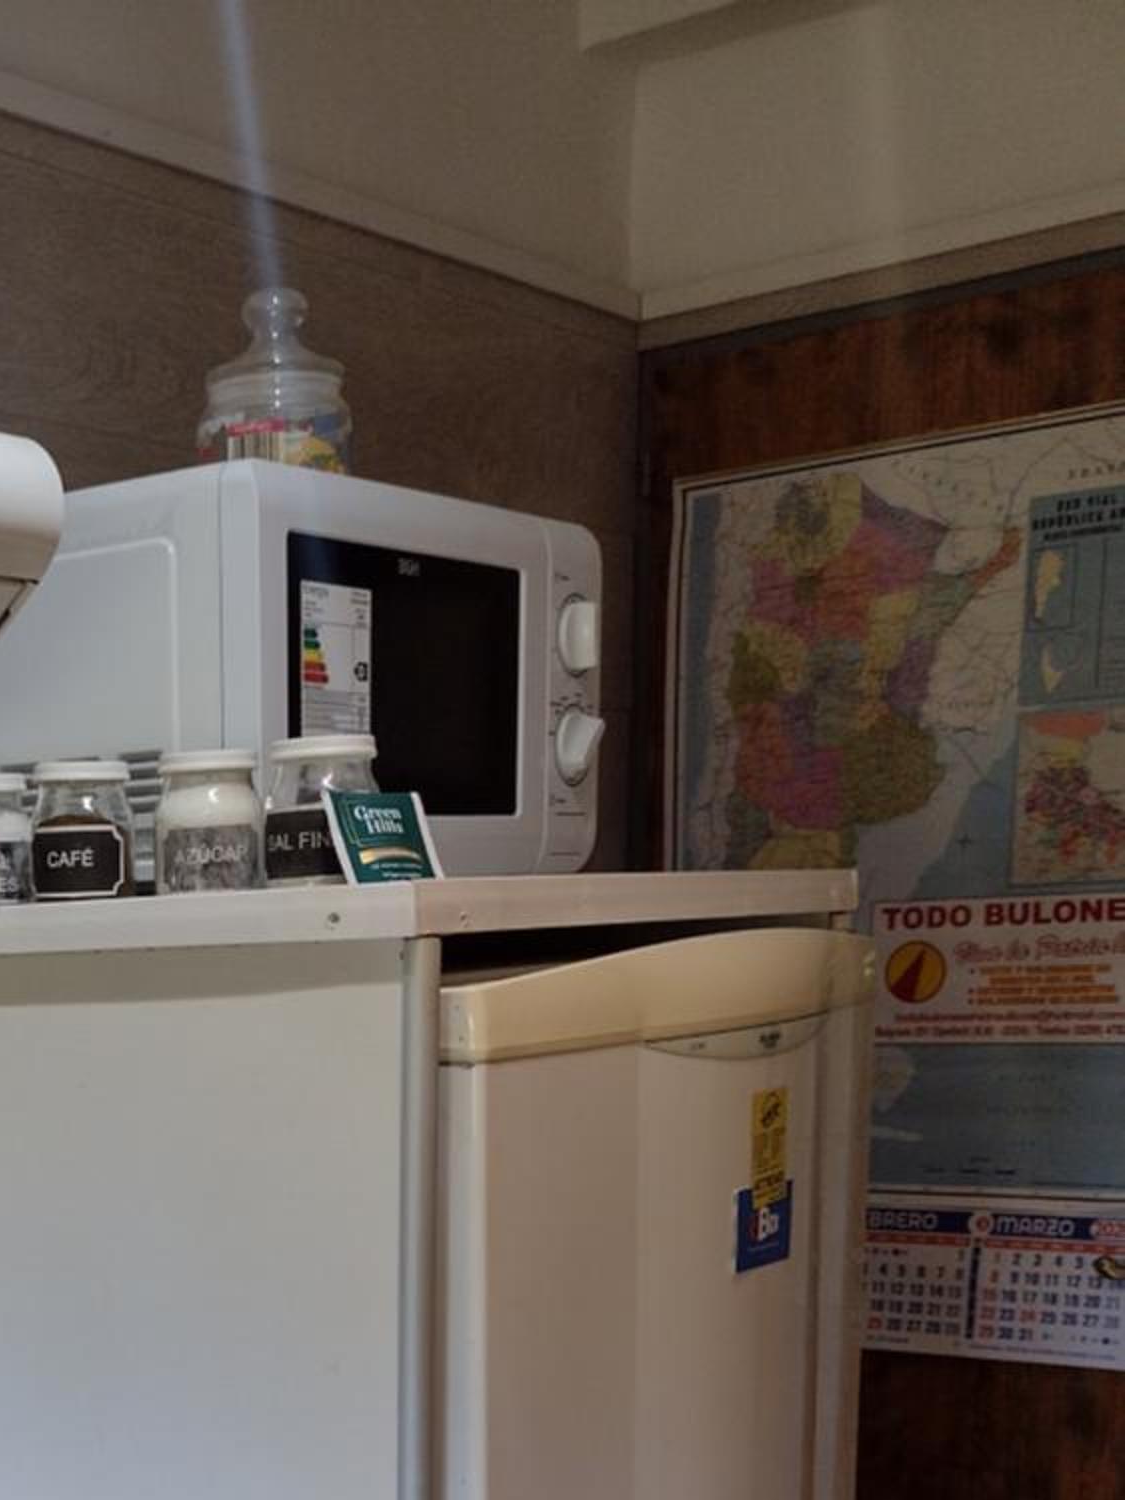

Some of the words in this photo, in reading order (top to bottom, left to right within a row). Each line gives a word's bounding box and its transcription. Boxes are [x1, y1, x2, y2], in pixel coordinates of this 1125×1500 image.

[354, 805, 403, 822] Green
[366, 818, 405, 835] Hills
[267, 832, 295, 852] SAL
[299, 831, 332, 849] FIN
[46, 845, 95, 868] CAFÉ
[173, 842, 249, 865] AZÚCAR
[882, 904, 972, 930] TODO
[1025, 1272, 1040, 1285] 10
[1045, 1274, 1059, 1286] 11
[1022, 1291, 1038, 1304] 17
